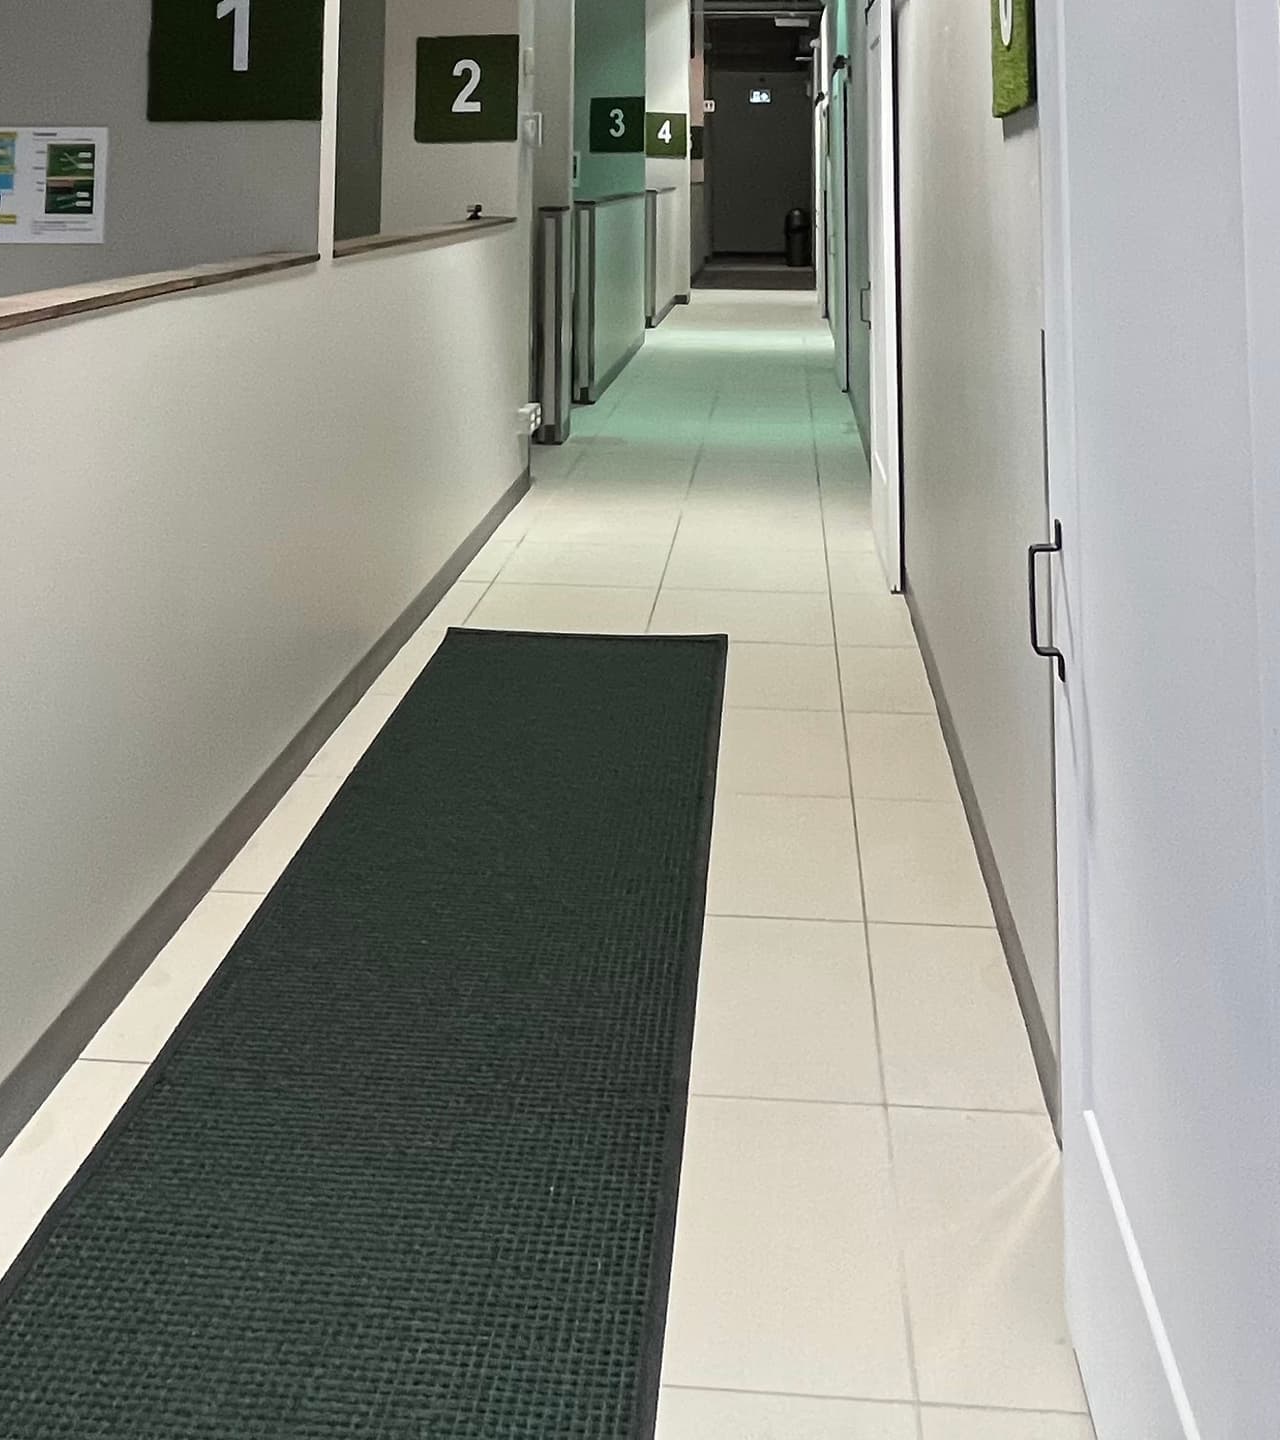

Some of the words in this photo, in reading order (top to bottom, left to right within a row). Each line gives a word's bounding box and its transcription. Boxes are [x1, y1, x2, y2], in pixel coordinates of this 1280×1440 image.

[451, 59, 482, 113] 2
[609, 108, 626, 138] 3
[657, 120, 672, 144] 4
